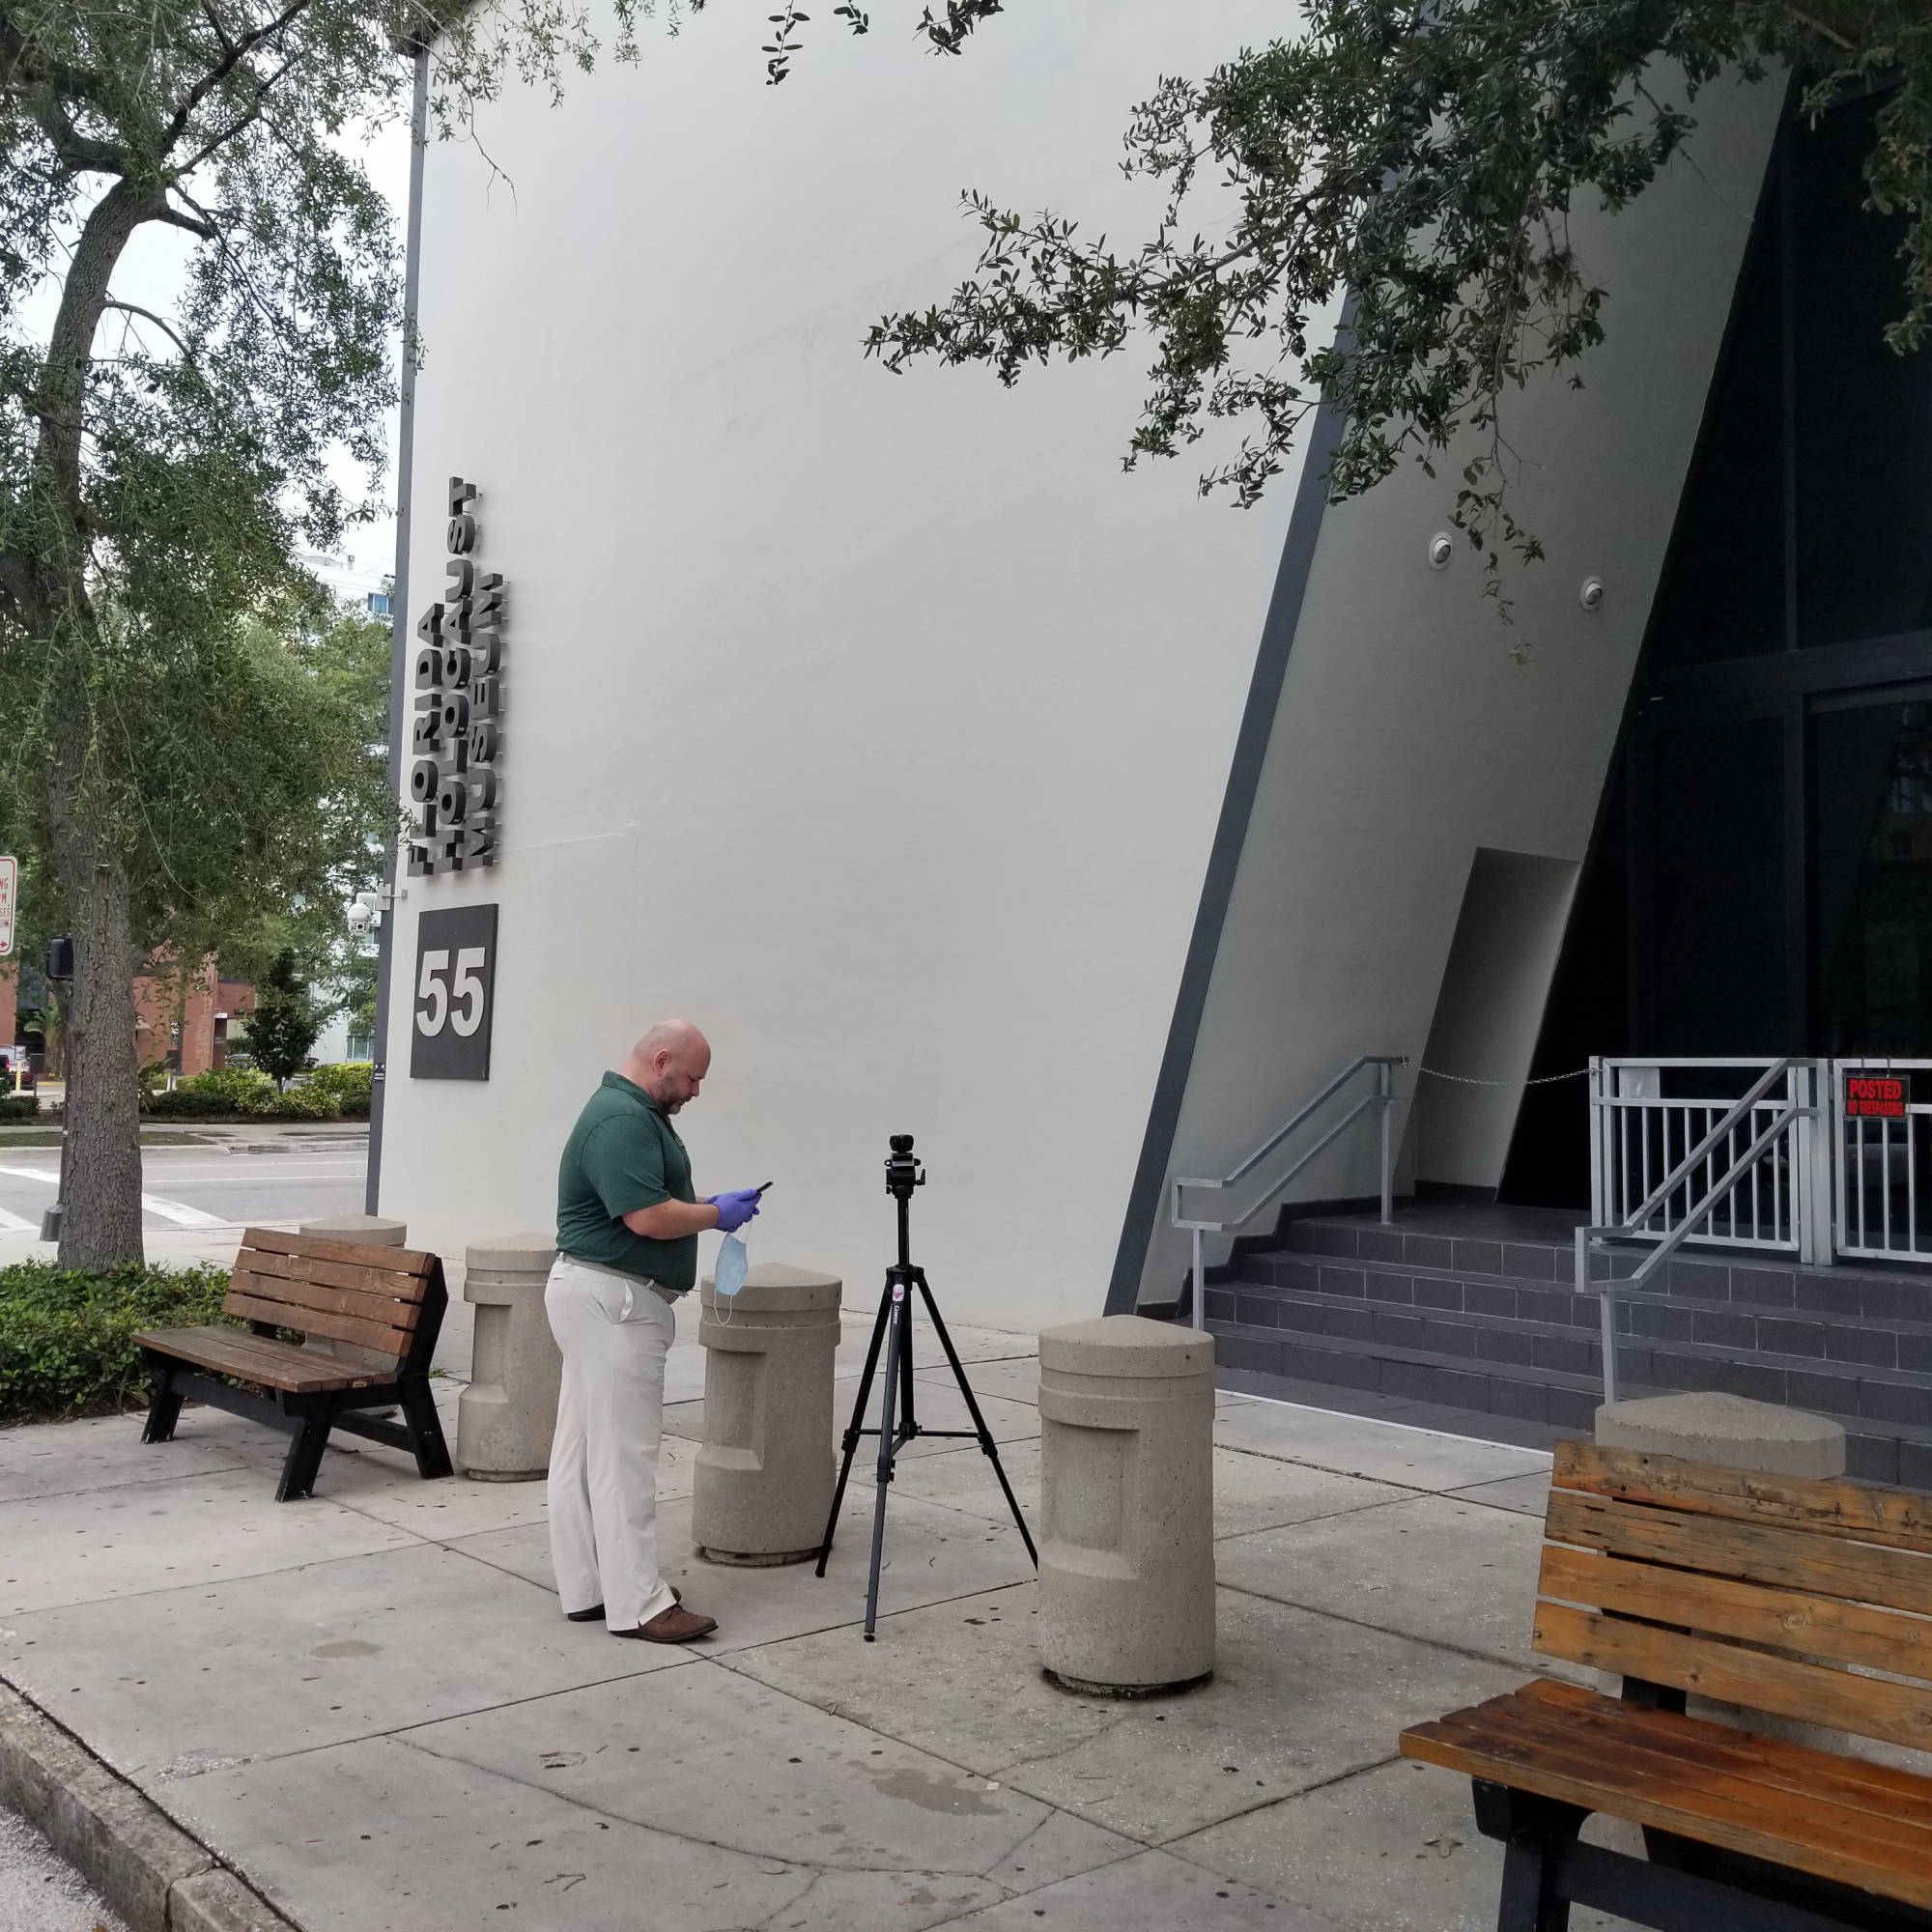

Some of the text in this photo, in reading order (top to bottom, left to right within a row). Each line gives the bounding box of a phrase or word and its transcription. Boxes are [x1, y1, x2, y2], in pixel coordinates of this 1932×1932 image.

[407, 602, 444, 877] FLORIDA
[436, 476, 477, 872] HOLOCAUST
[463, 573, 503, 870] MUSEUM
[416, 947, 485, 1037] 55
[1849, 1079, 1902, 1099] POSTED
